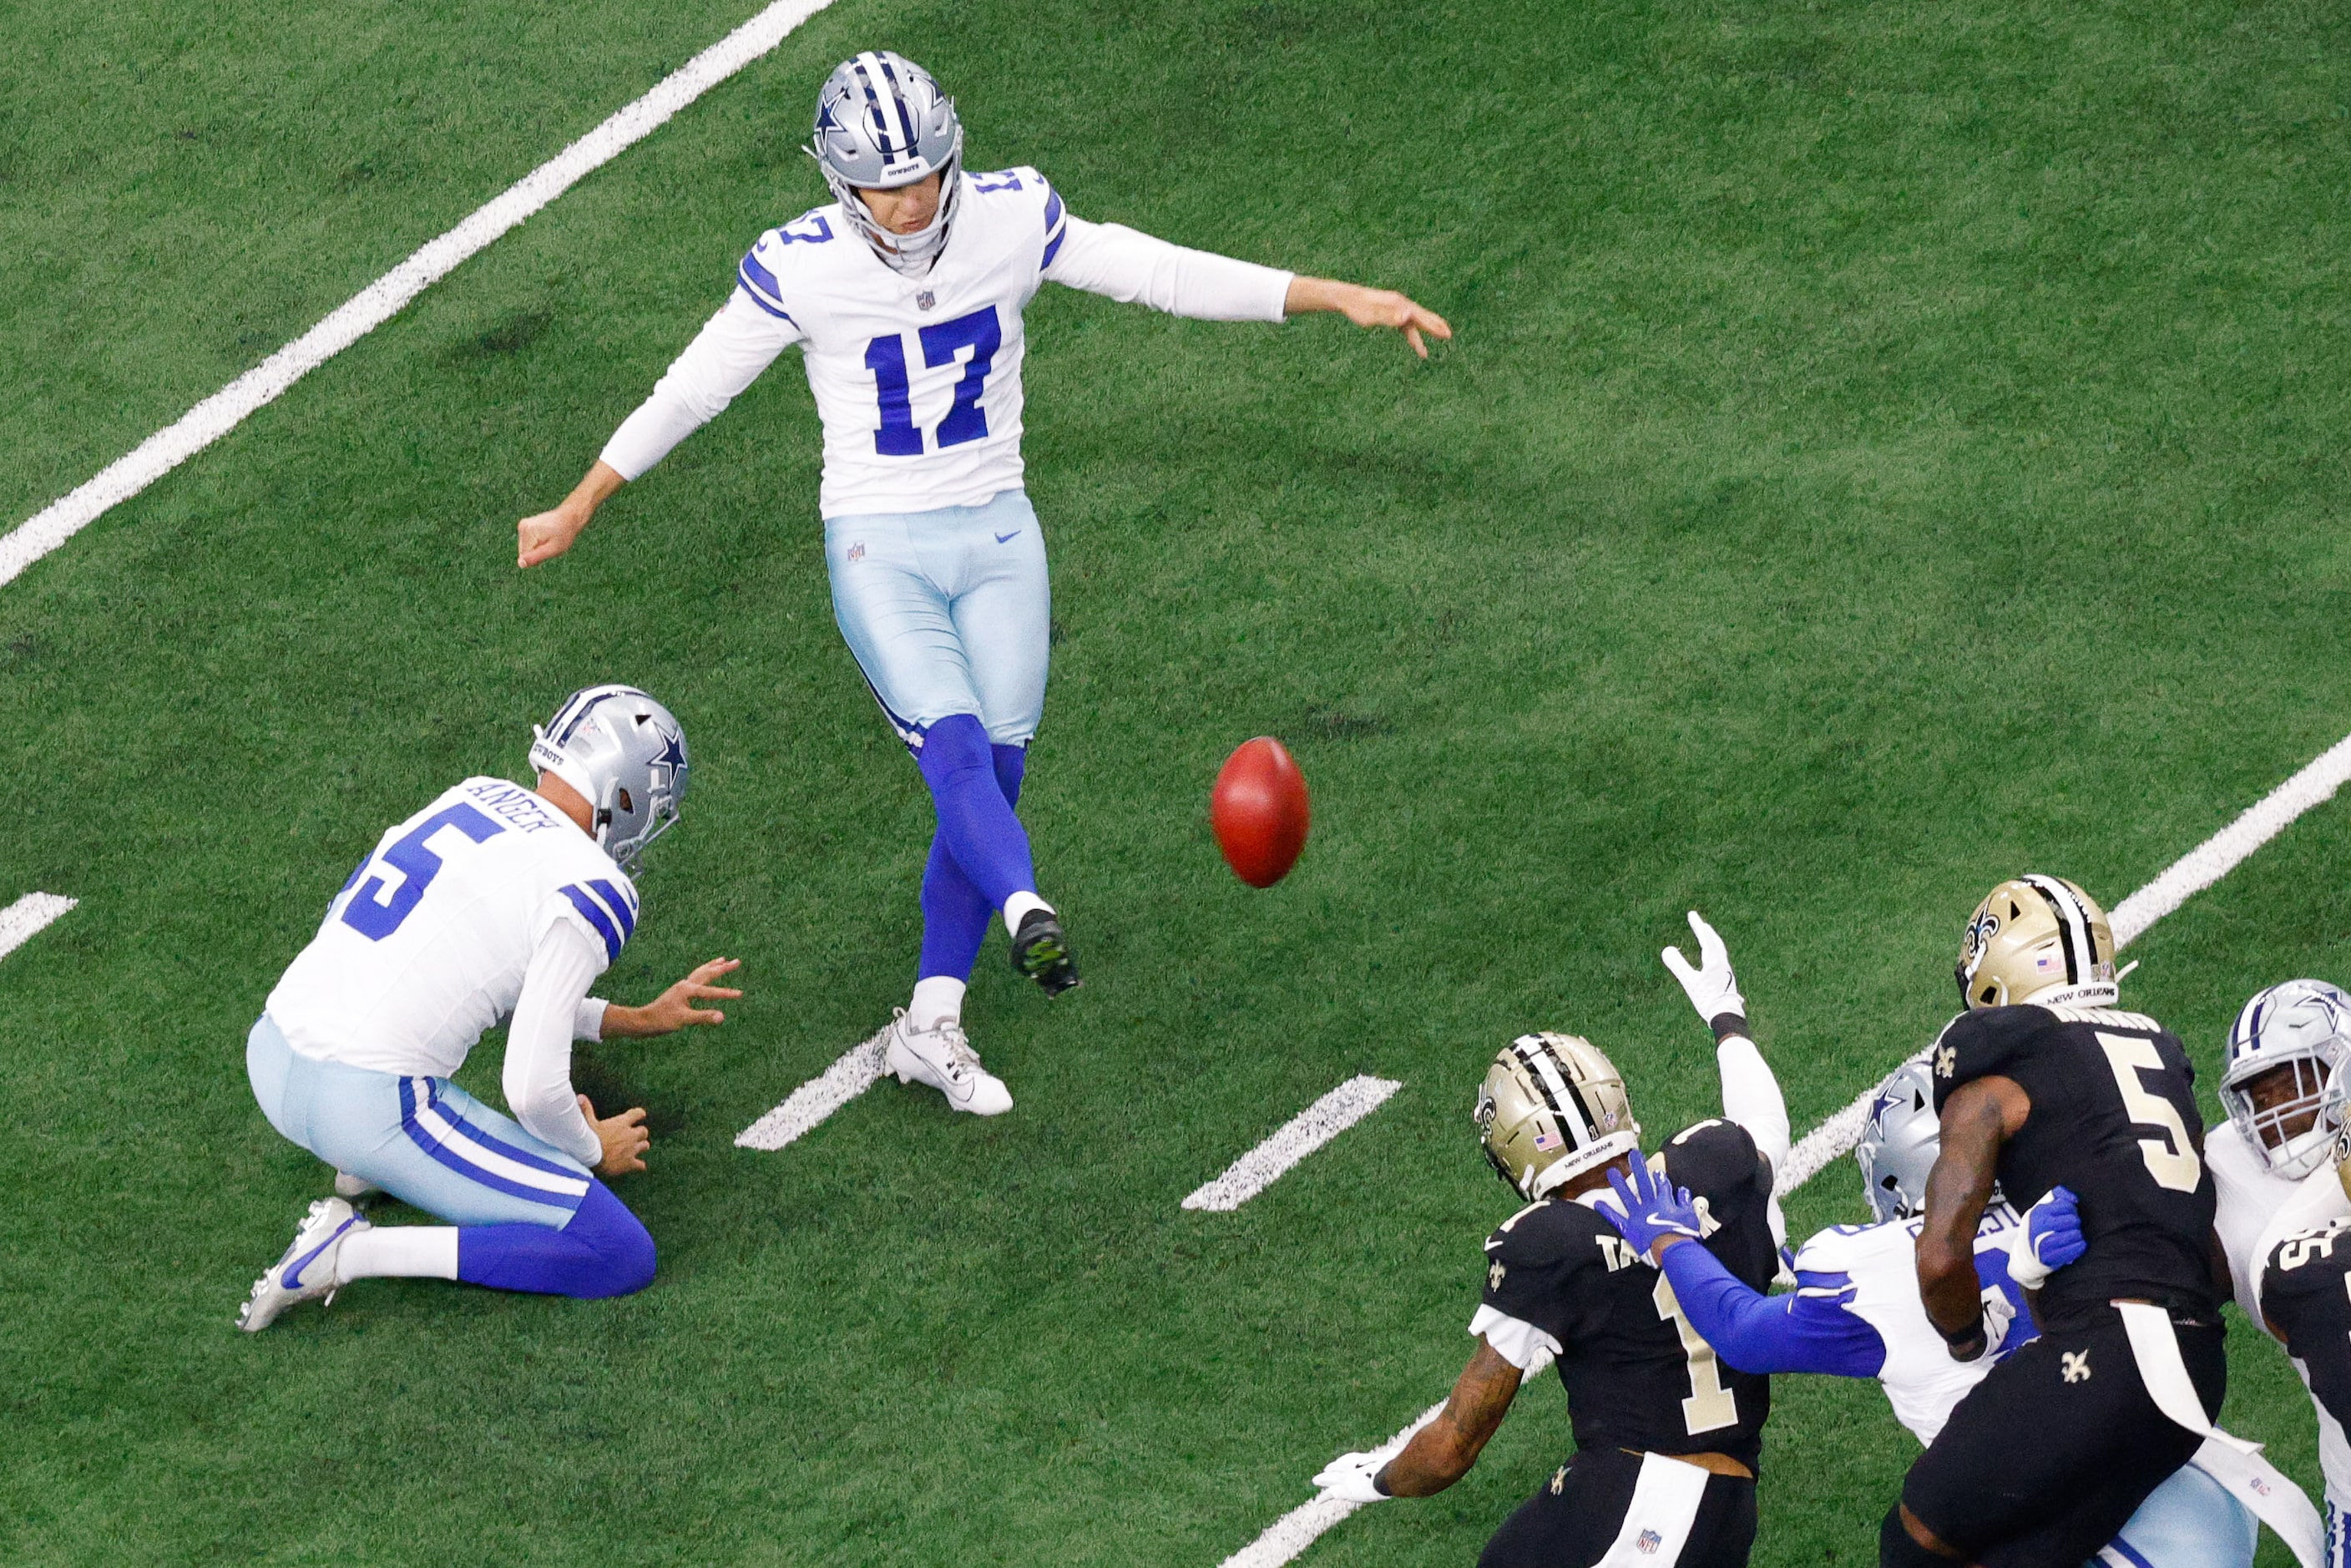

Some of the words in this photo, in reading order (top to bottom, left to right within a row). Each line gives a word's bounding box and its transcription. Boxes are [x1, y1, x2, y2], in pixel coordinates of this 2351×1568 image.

[887, 163, 919, 176] COWBOYS
[864, 304, 1002, 455] 17
[535, 743, 564, 766] BOYS
[467, 784, 563, 832] ANGER
[341, 802, 506, 942] 5
[2047, 991, 2074, 1004] NEW
[2078, 987, 2115, 999] ORLEANS
[2095, 1031, 2202, 1194] 5
[1588, 1124, 1600, 1141] 1
[1564, 1156, 1581, 1169] NEW
[1583, 1141, 1614, 1159] ORLEANS
[1652, 1268, 1738, 1436] 1
